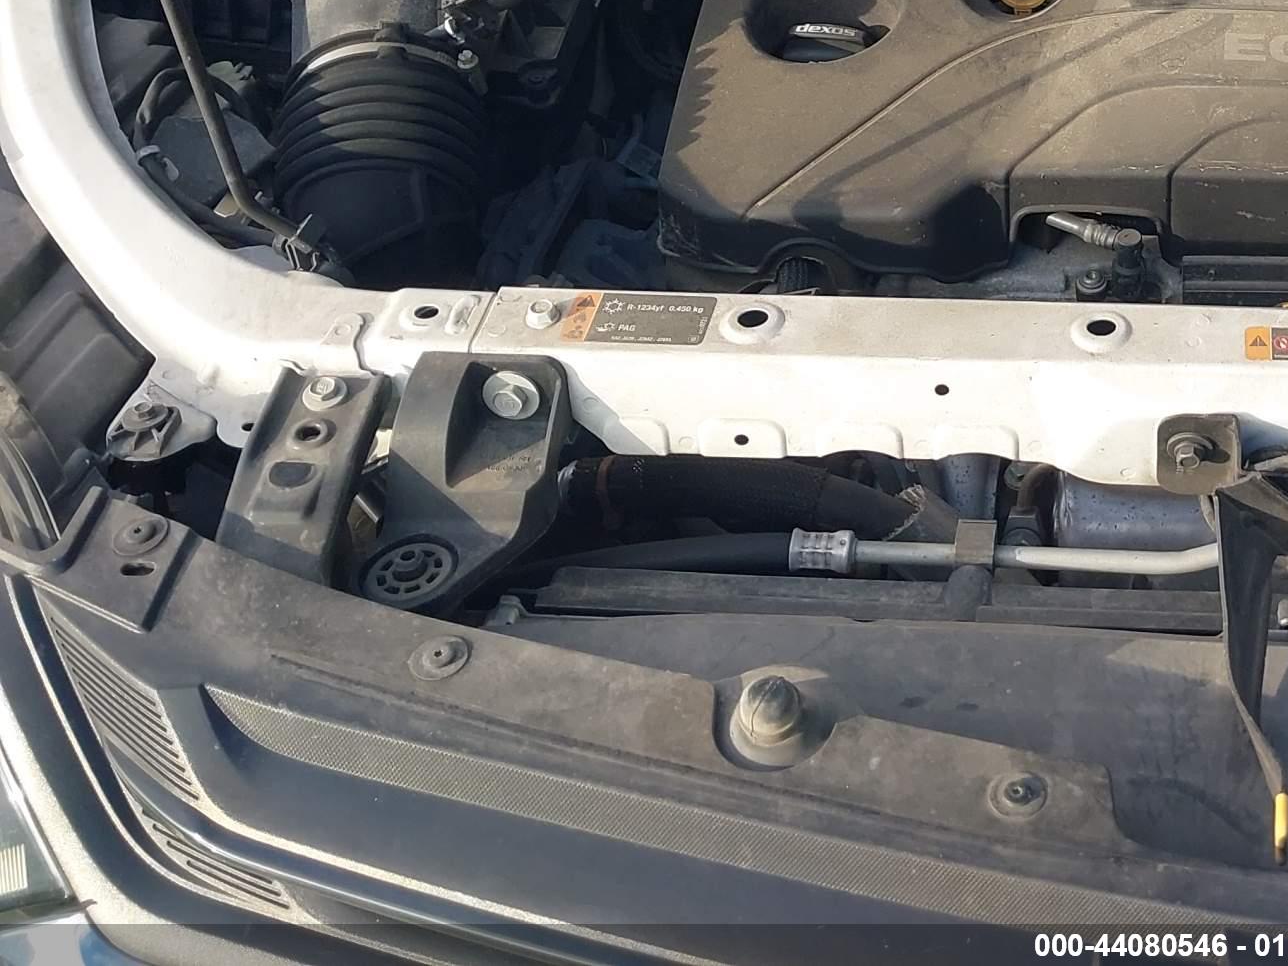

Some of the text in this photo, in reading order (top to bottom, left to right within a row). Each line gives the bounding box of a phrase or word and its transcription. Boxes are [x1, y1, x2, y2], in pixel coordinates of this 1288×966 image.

[795, 23, 857, 37] dexos
[626, 303, 664, 313] R-1234yf
[692, 306, 704, 314] kg
[617, 323, 637, 332] PAG
